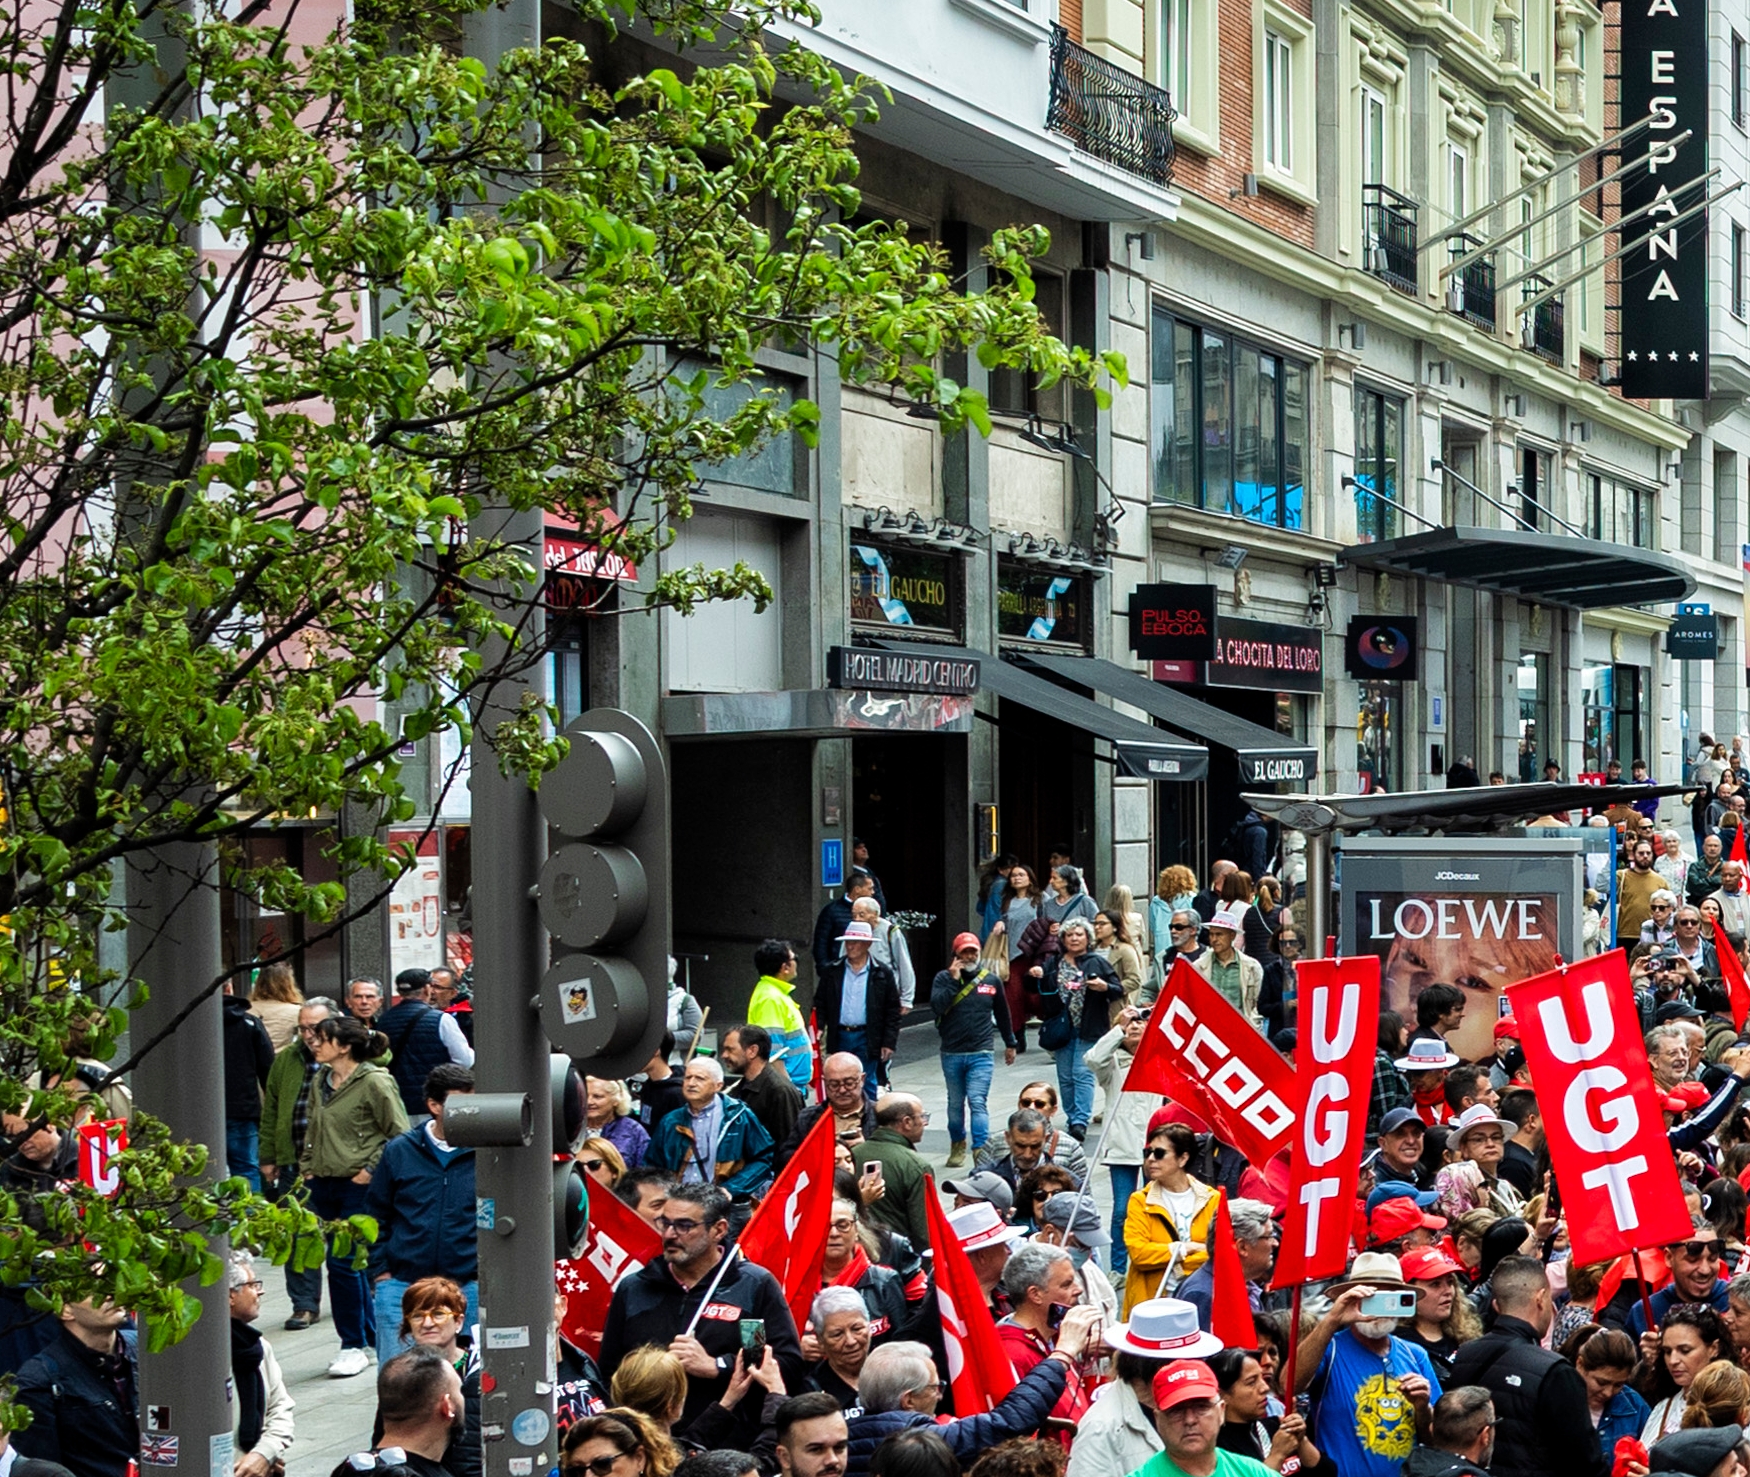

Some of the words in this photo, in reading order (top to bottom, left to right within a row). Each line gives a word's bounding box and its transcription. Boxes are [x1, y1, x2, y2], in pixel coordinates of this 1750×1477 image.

[1647, 50, 1679, 302] ESPAÑA
[889, 575, 946, 606] GAUCHO
[1674, 631, 1714, 639] AROMES
[844, 653, 883, 682] HOTEL
[882, 657, 931, 686] MADRID
[931, 660, 976, 688] CENTRO
[1227, 639, 1275, 668] CHOCITA
[1276, 643, 1296, 669] DEL
[1295, 646, 1320, 672] LORO
[1253, 761, 1265, 781] EL
[1266, 759, 1304, 781] GAUCHO
[1435, 871, 1481, 881] JCDecaux
[1370, 899, 1544, 941] LOEWE
[1159, 995, 1297, 1140] CCOO
[1299, 982, 1362, 1258] UGT
[1537, 981, 1648, 1232] UGT
